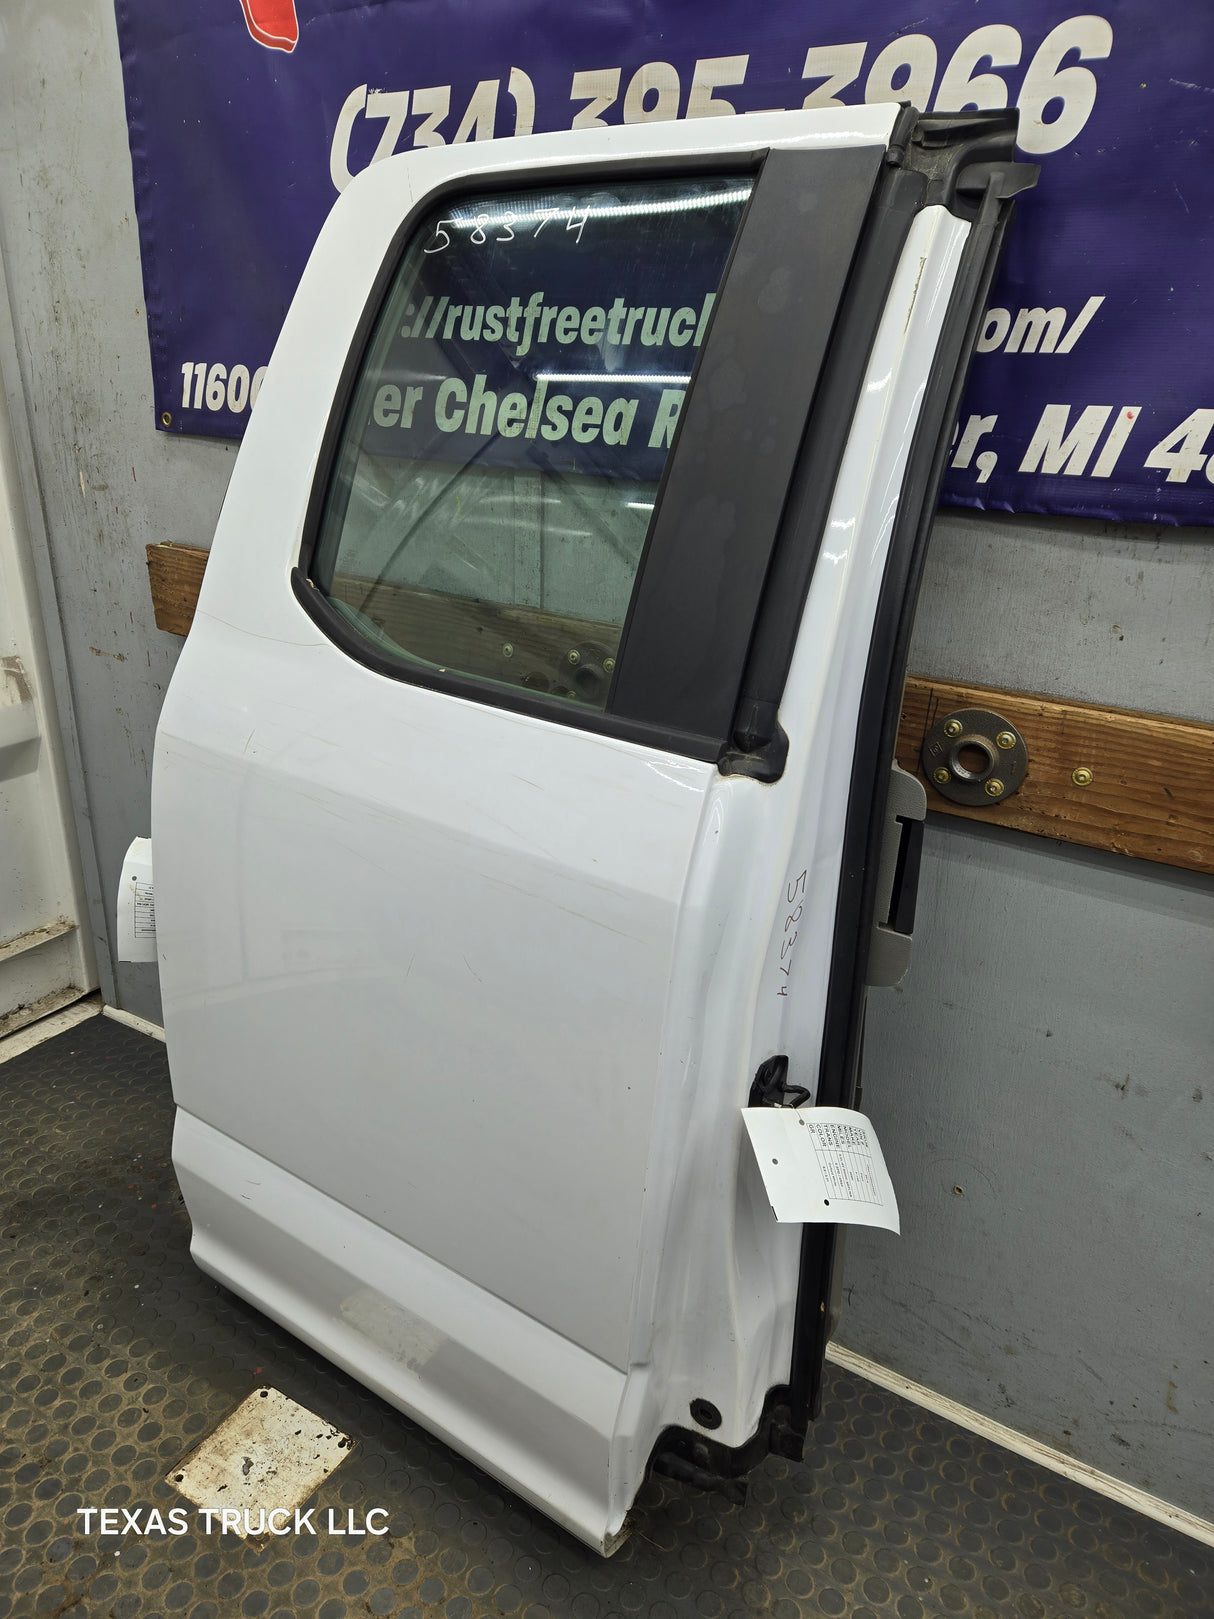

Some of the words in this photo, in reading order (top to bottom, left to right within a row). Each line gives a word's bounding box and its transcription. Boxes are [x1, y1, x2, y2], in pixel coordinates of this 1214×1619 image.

[569, 15, 1114, 154] 3953966
[424, 205, 590, 253] 58374
[367, 384, 424, 429] er
[434, 374, 639, 446] Chelsea
[949, 414, 999, 484] r,
[1018, 404, 1142, 478] MI
[1143, 408, 1214, 485] 4
[777, 870, 807, 997] 58374
[816, 1124, 827, 1147] COLOR
[824, 1124, 833, 1146] TRANS
[830, 1124, 840, 1148] ENGINE
[837, 1125, 845, 1145] MILES
[843, 1126, 851, 1148] MODEL
